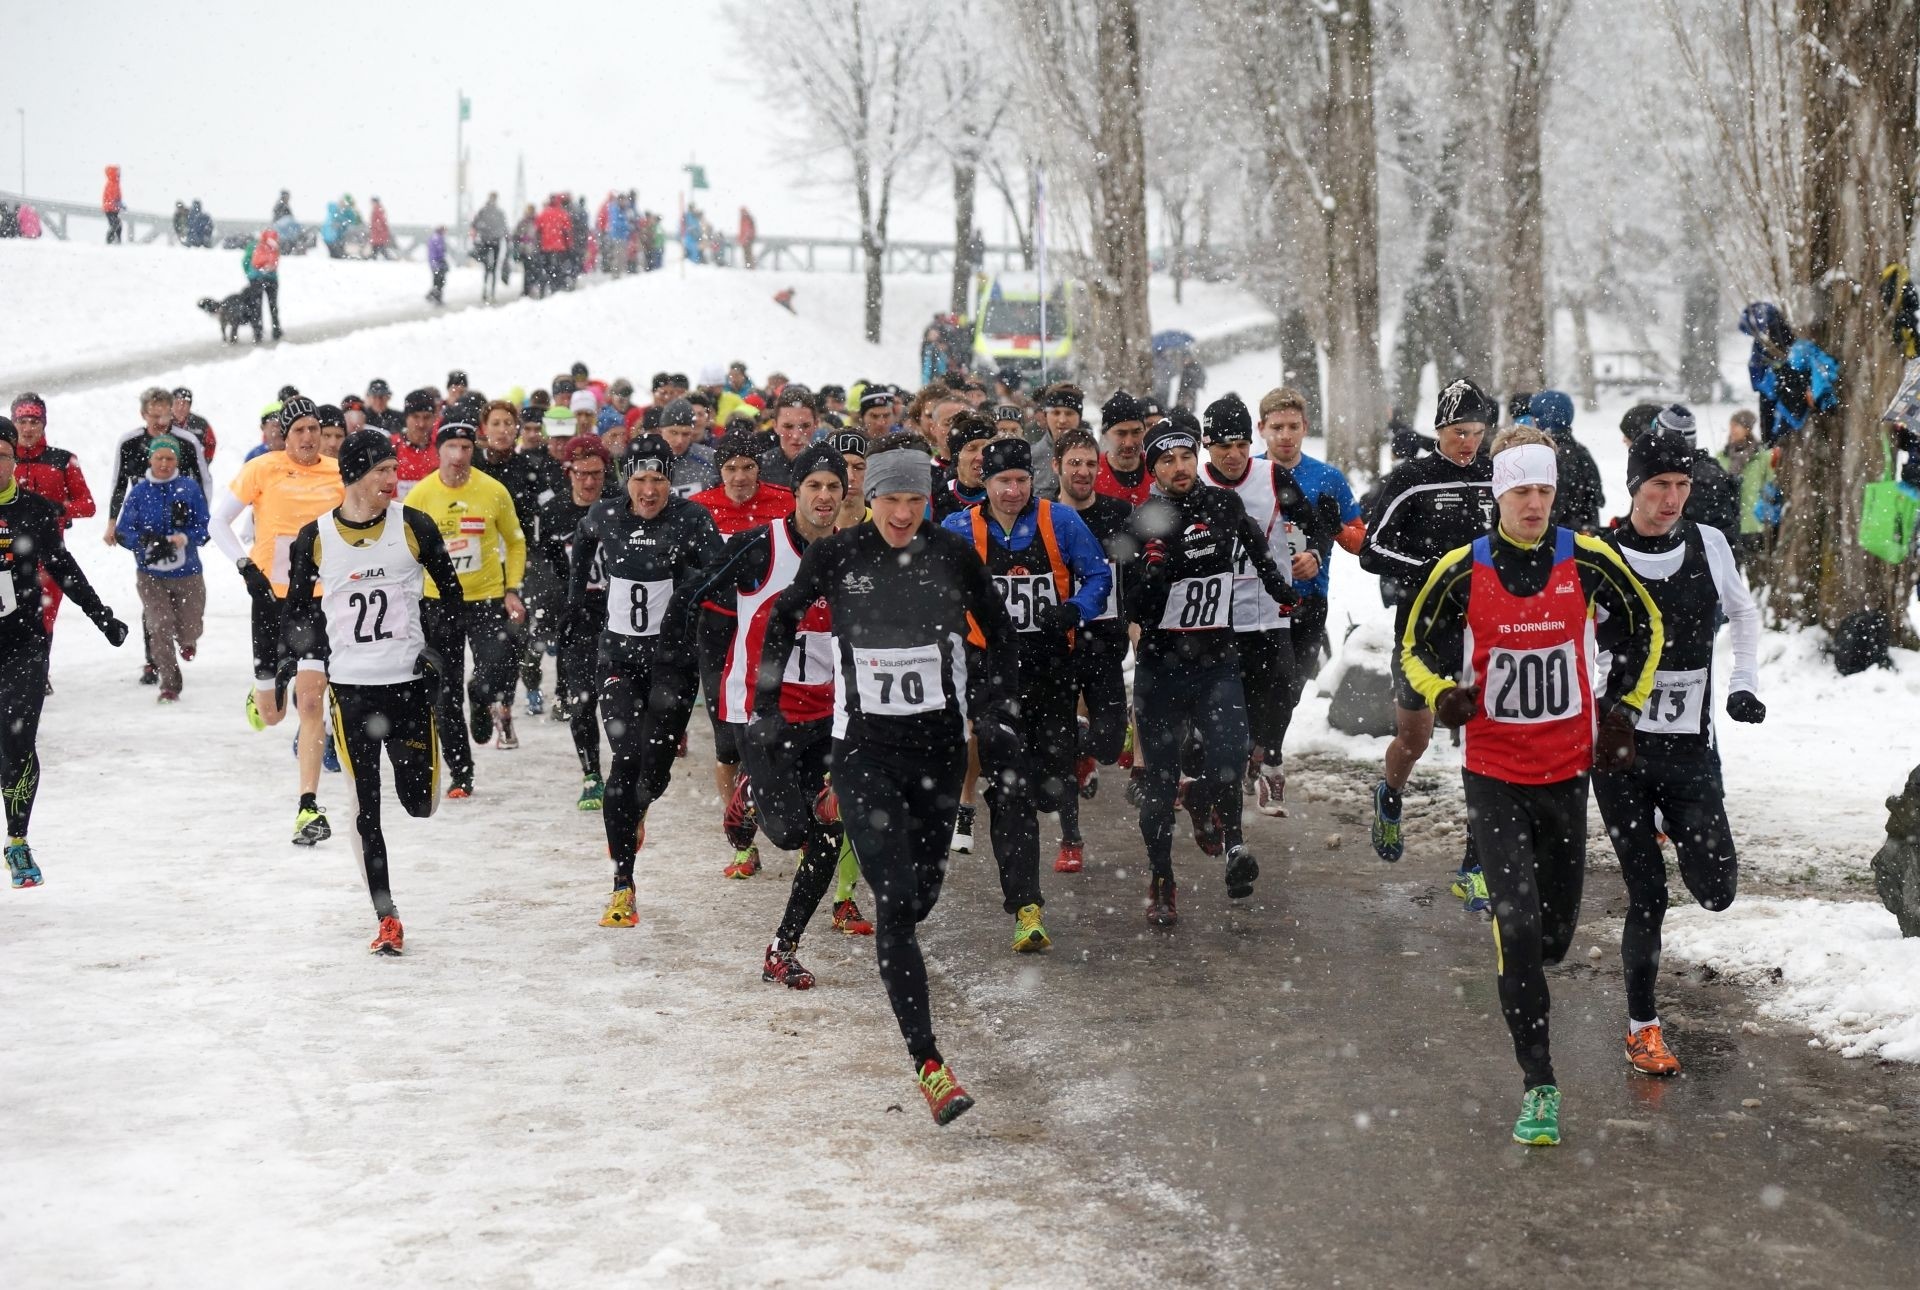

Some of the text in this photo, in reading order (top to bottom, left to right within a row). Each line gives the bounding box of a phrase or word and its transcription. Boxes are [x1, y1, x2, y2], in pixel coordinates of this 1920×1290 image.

[628, 537, 657, 546] skinfit
[1184, 530, 1212, 543] skinfit
[349, 588, 393, 643] 22
[630, 583, 649, 633] 8
[1179, 577, 1222, 628] 88
[1499, 621, 1566, 634] TS DORNBIRN
[856, 657, 869, 666] Die
[873, 671, 925, 705] 70
[1494, 648, 1570, 719] 200
[1648, 688, 1686, 723] 13
